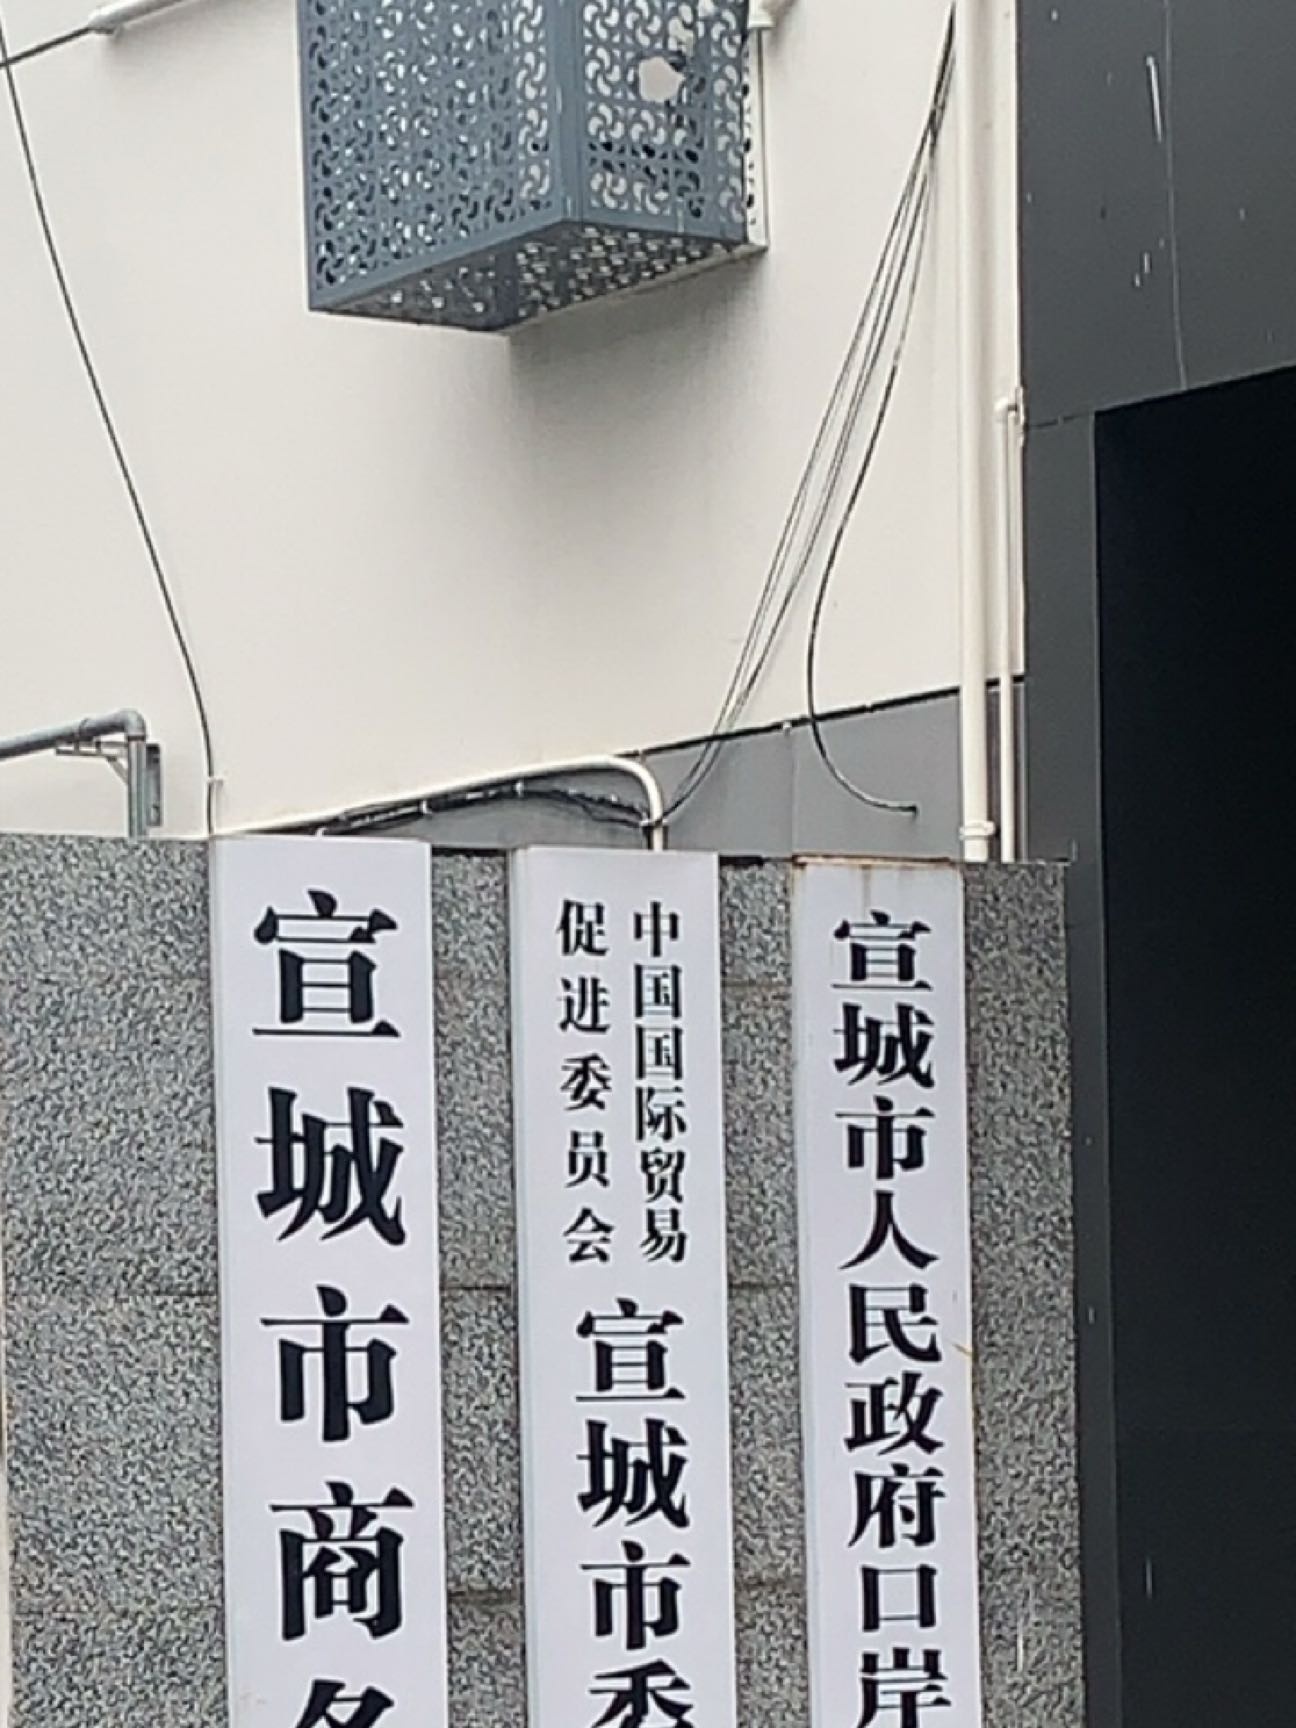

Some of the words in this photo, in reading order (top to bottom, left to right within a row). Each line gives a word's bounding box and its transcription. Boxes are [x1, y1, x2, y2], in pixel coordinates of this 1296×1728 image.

[555, 899, 614, 1264] 促进委员会
[632, 899, 688, 1264] 中国国际贸易
